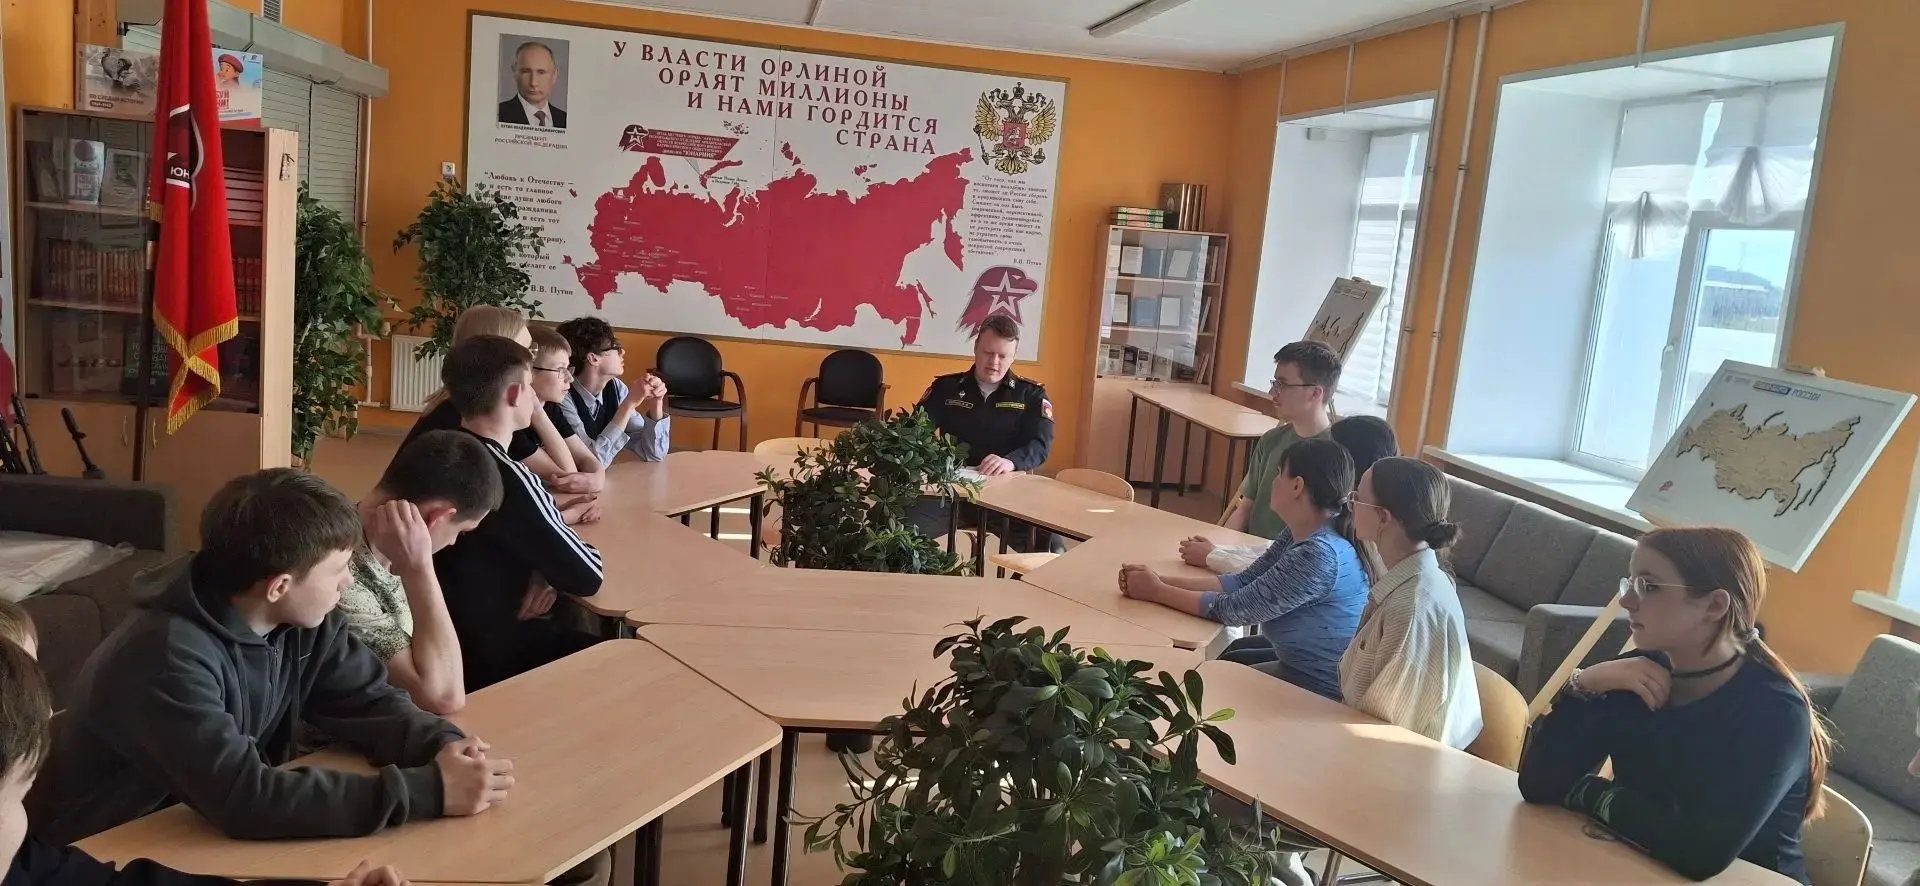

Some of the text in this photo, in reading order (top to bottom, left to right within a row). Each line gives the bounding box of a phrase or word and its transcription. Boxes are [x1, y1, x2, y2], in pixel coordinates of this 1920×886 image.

[613, 40, 887, 88] У ВЛАСТИ ОРЛИНОЙ
[658, 67, 909, 112] ОРЛЯТ МИЛЛИОНЫ
[687, 91, 939, 135] И НАМИ ГОРДИТСЯ
[836, 129, 937, 155] СТРАНА
[527, 175, 564, 187] Отечеству
[514, 195, 534, 204] души
[536, 196, 562, 205] любого
[517, 205, 558, 215] ражданина
[530, 284, 574, 296] В.В. Путин
